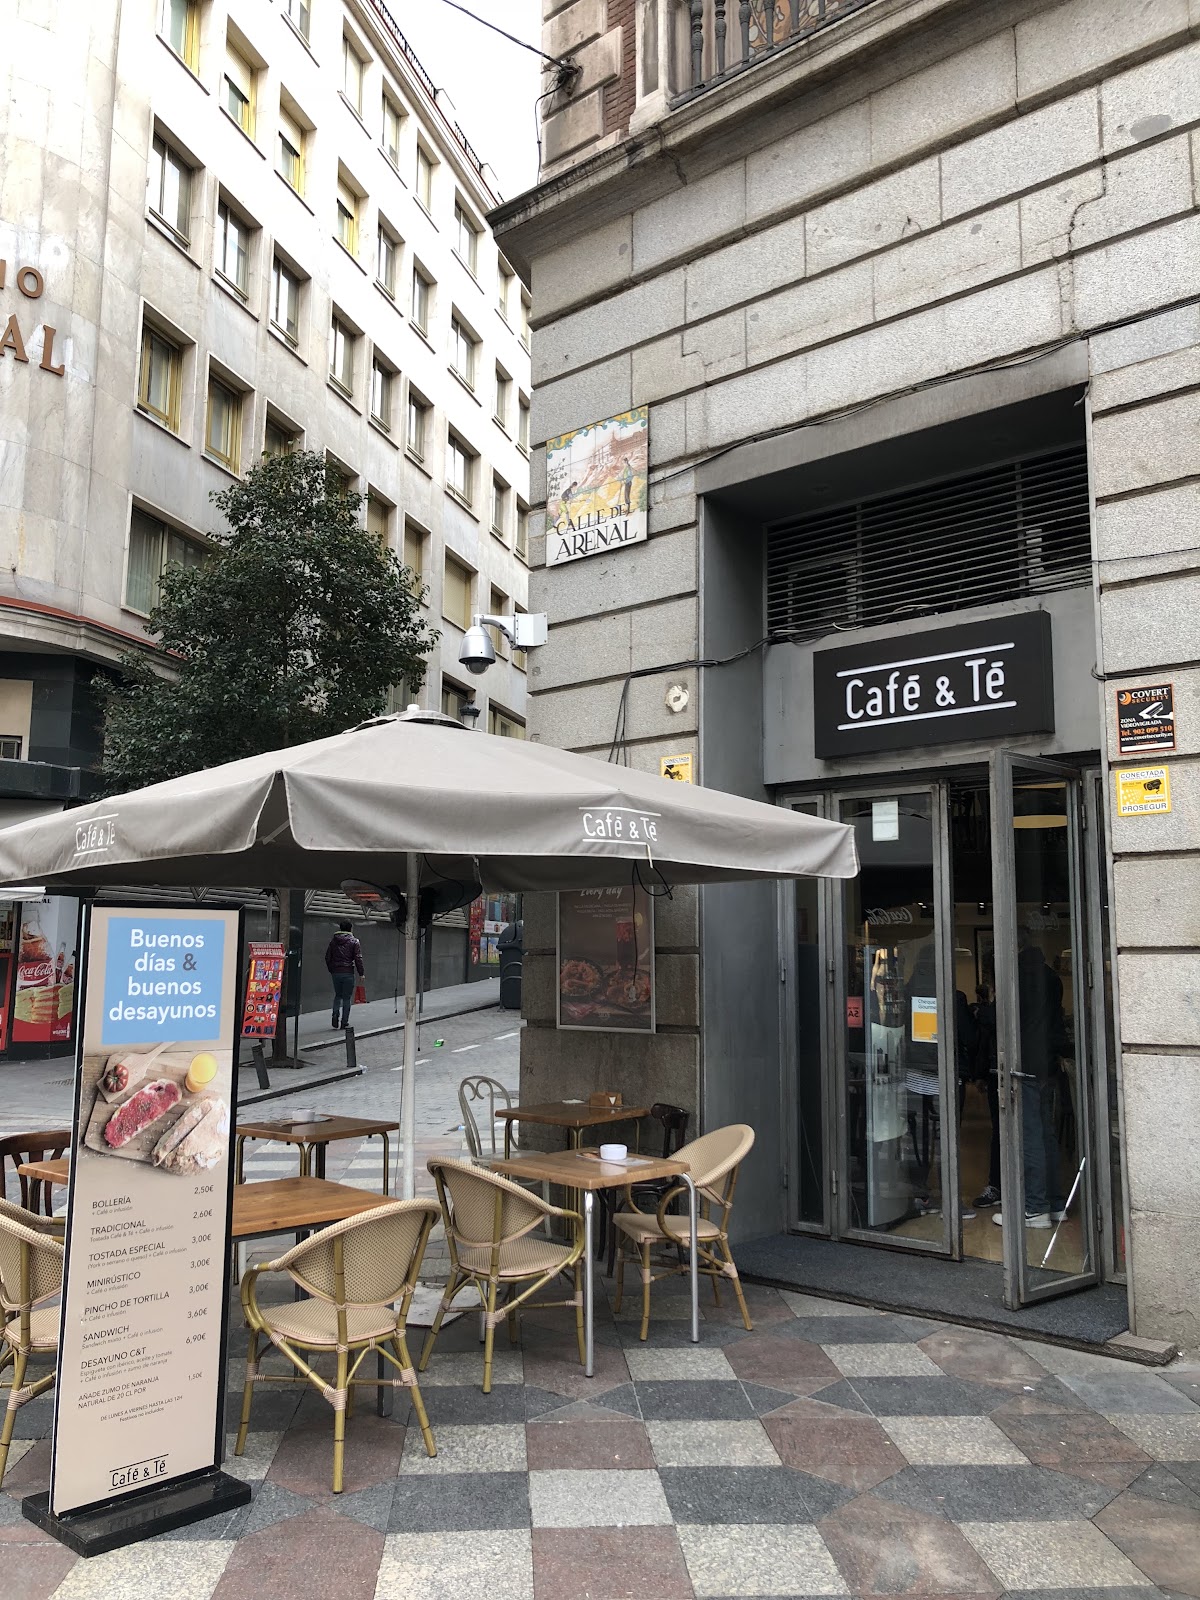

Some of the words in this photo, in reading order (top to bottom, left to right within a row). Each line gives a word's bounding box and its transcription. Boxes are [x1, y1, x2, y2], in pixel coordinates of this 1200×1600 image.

[555, 508, 607, 536] CALLE
[555, 520, 638, 561] ARENAL
[935, 676, 956, 706] &
[1131, 687, 1168, 699] COVERT
[1131, 694, 1169, 704] SECURITY
[1120, 719, 1162, 729] VIDEOVIGILADA
[1121, 729, 1131, 737] Tel.
[1133, 728, 1145, 736] 902
[1146, 726, 1159, 734] 099
[1120, 769, 1165, 779] CONECTADA
[1122, 802, 1167, 813] PROSEGUR
[97, 829, 104, 847] &
[629, 821, 640, 839] &
[130, 928, 205, 949] Buenos
[134, 953, 176, 972] días
[182, 953, 197, 972] &
[128, 976, 202, 997] buenos
[109, 1000, 217, 1025] desayunos
[92, 1196, 131, 1209] BOLLERÍA
[194, 1185, 214, 1195] 2,50€
[91, 1219, 146, 1235] TRADICIONAL
[193, 1209, 213, 1219] 2,60€
[89, 1248, 127, 1261] TOSTADA
[129, 1241, 166, 1255] ESPECIAL
[191, 1233, 211, 1244] 3,00€
[86, 1271, 141, 1289] MINIRÚSTICO
[190, 1258, 210, 1269] 3,00€
[84, 1301, 118, 1315] PINCHO
[120, 1298, 131, 1308] DE
[133, 1291, 170, 1305] TORTILLA
[189, 1282, 209, 1294] 3,00€
[83, 1325, 130, 1343] SANDWICH
[187, 1307, 207, 1319] 3,60€
[81, 1351, 128, 1370] DESAYUNO
[129, 1346, 147, 1358] C&T
[185, 1333, 206, 1344] 6,90€
[78, 1391, 101, 1402] AÑADE
[101, 1385, 121, 1396] ZUMO
[121, 1382, 130, 1390] DE
[131, 1376, 159, 1388] NARANJA
[188, 1371, 203, 1382] 1,50€
[78, 1396, 106, 1409] NATURAL
[116, 1392, 125, 1400] 20
[125, 1389, 133, 1398] CL
[133, 1386, 147, 1395] POR
[108, 1410, 124, 1419] LUNES
[129, 1404, 148, 1414] VIERNES
[148, 1400, 164, 1409] HASTA
[143, 1466, 150, 1477] &
